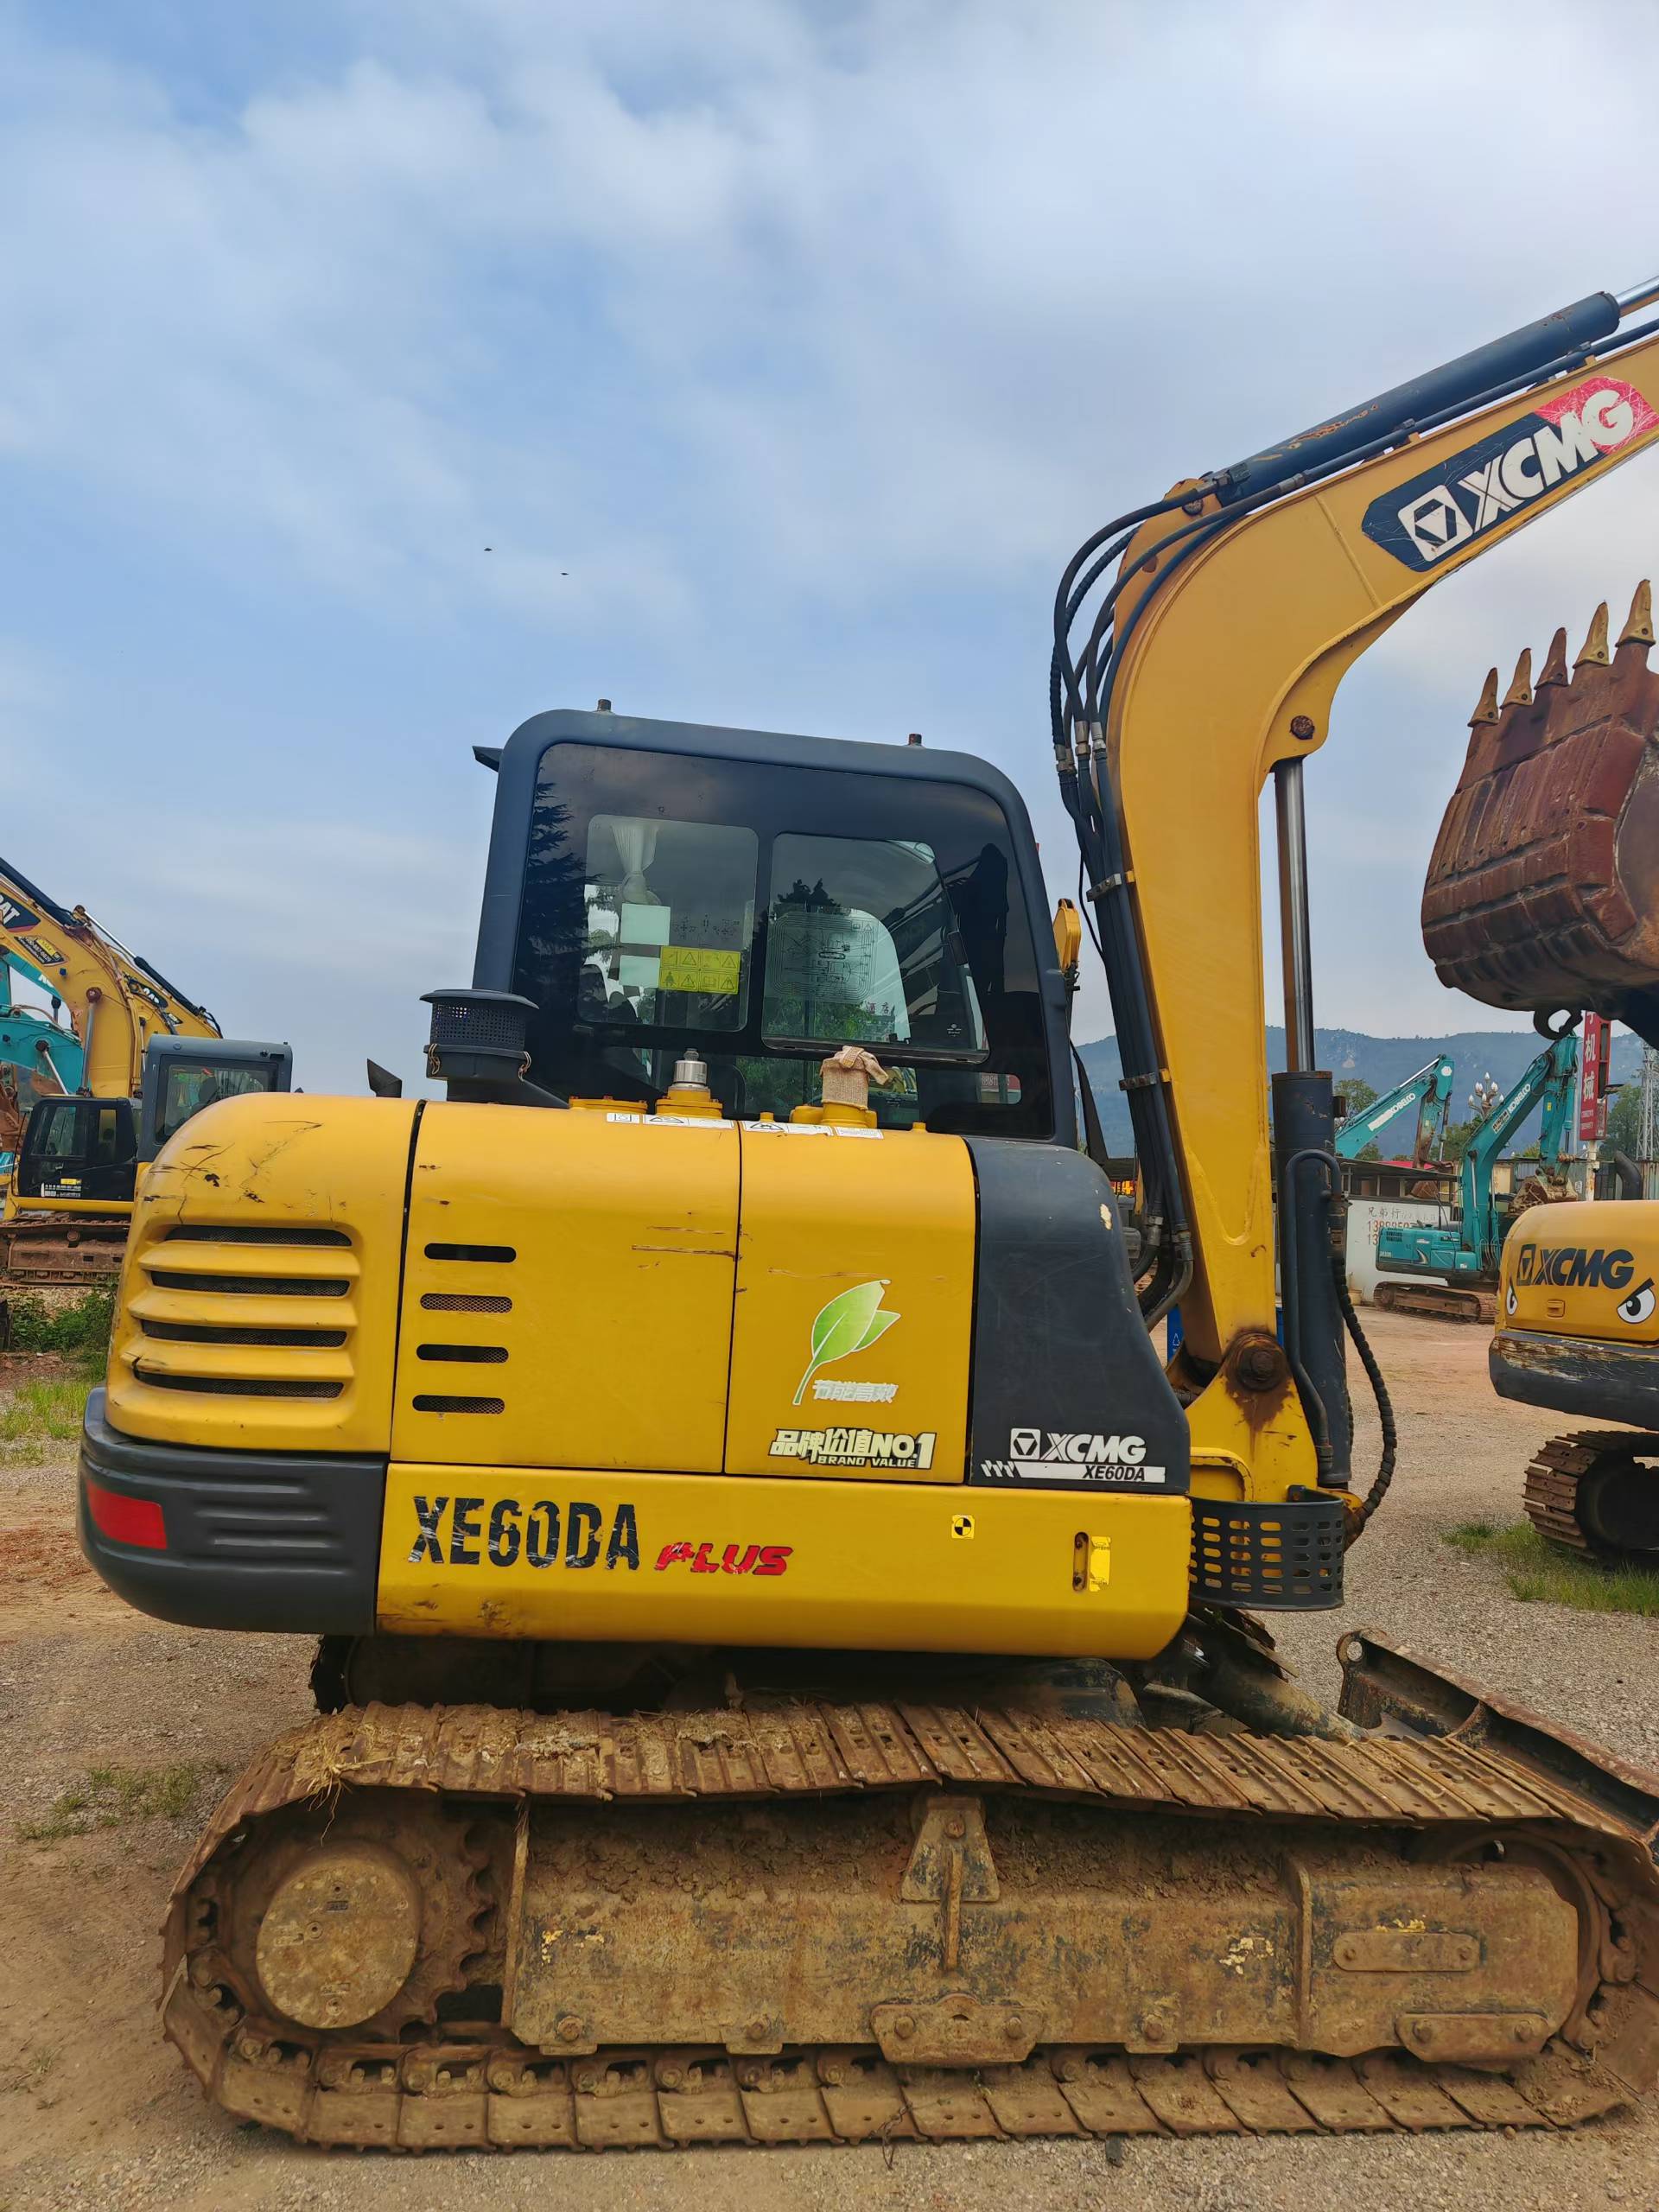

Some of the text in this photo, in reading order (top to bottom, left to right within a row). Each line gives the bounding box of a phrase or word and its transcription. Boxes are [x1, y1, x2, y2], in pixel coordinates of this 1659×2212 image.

[1457, 389, 1634, 533] XCMG
[1507, 1084, 1531, 1115] KOBELCO
[1535, 1247, 1635, 1289] XCMG
[817, 1455, 916, 1468] BRAND VALUE
[1039, 1433, 1147, 1465] XCMG
[1083, 1465, 1146, 1482] XE60DA
[408, 1496, 640, 1572] XE60DA
